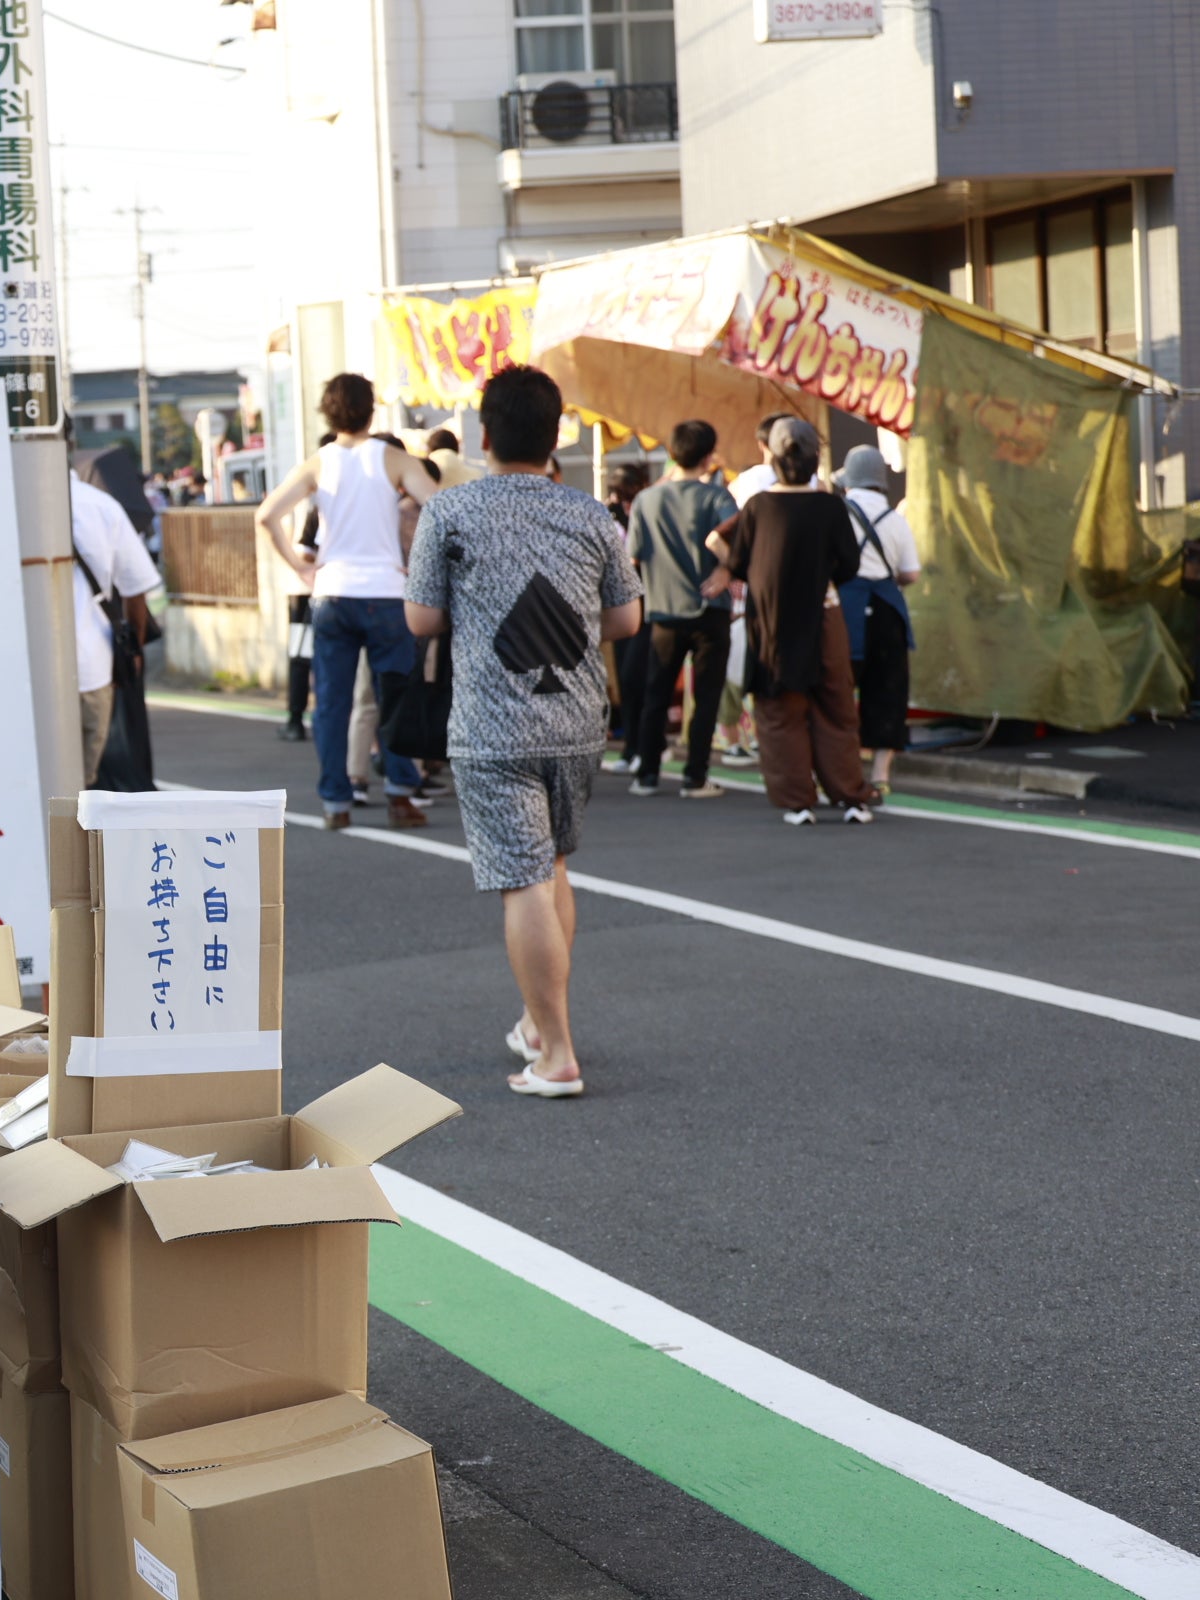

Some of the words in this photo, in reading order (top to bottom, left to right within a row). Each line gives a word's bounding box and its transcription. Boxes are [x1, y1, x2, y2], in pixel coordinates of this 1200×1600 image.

[147, 841, 180, 1031] お持ち下さい
[203, 831, 236, 1006] ご自由に
